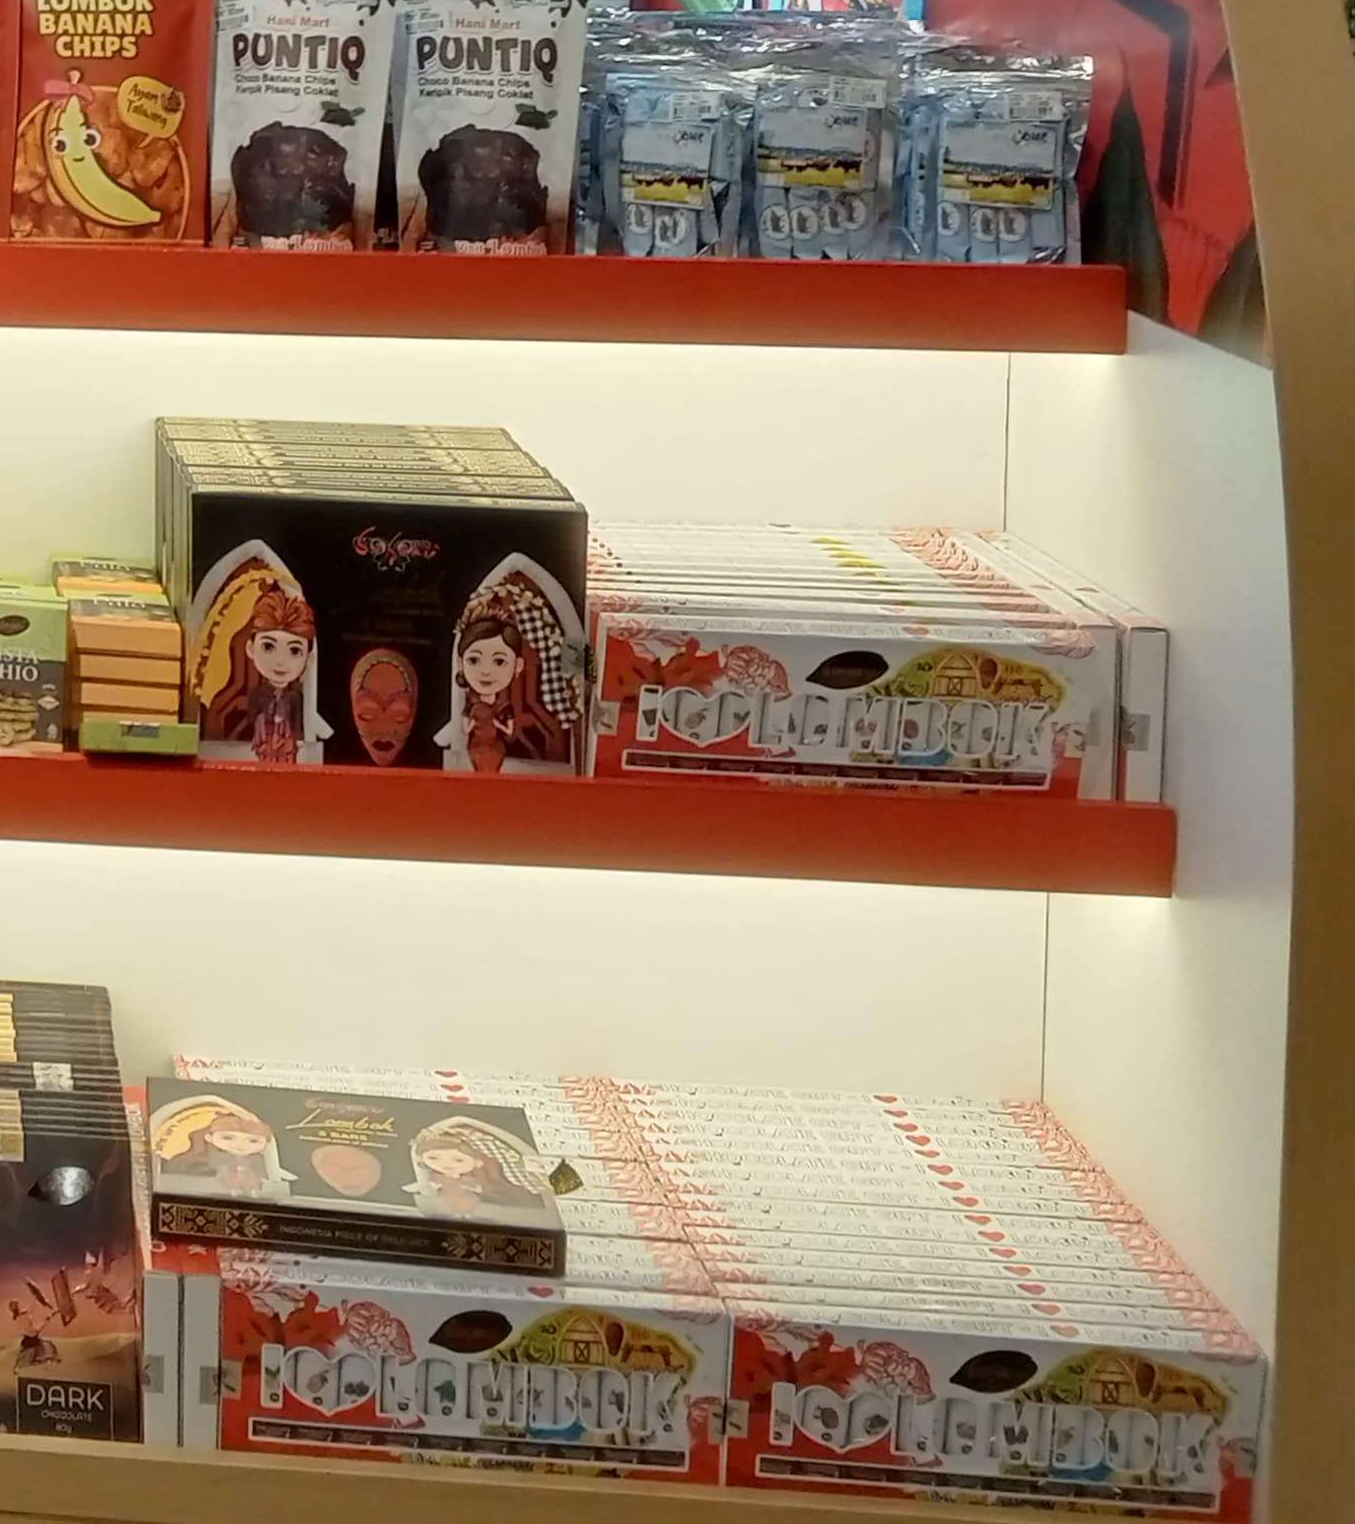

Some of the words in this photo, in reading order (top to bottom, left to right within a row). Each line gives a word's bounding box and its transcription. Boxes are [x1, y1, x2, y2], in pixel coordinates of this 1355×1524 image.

[38, 13, 153, 37] BANANA
[55, 35, 137, 58] CHIPS
[232, 32, 366, 82] PUNTIQ
[416, 35, 558, 83] PUNTIQ
[127, 85, 159, 104] Ayam
[26, 1383, 104, 1410] DARK
